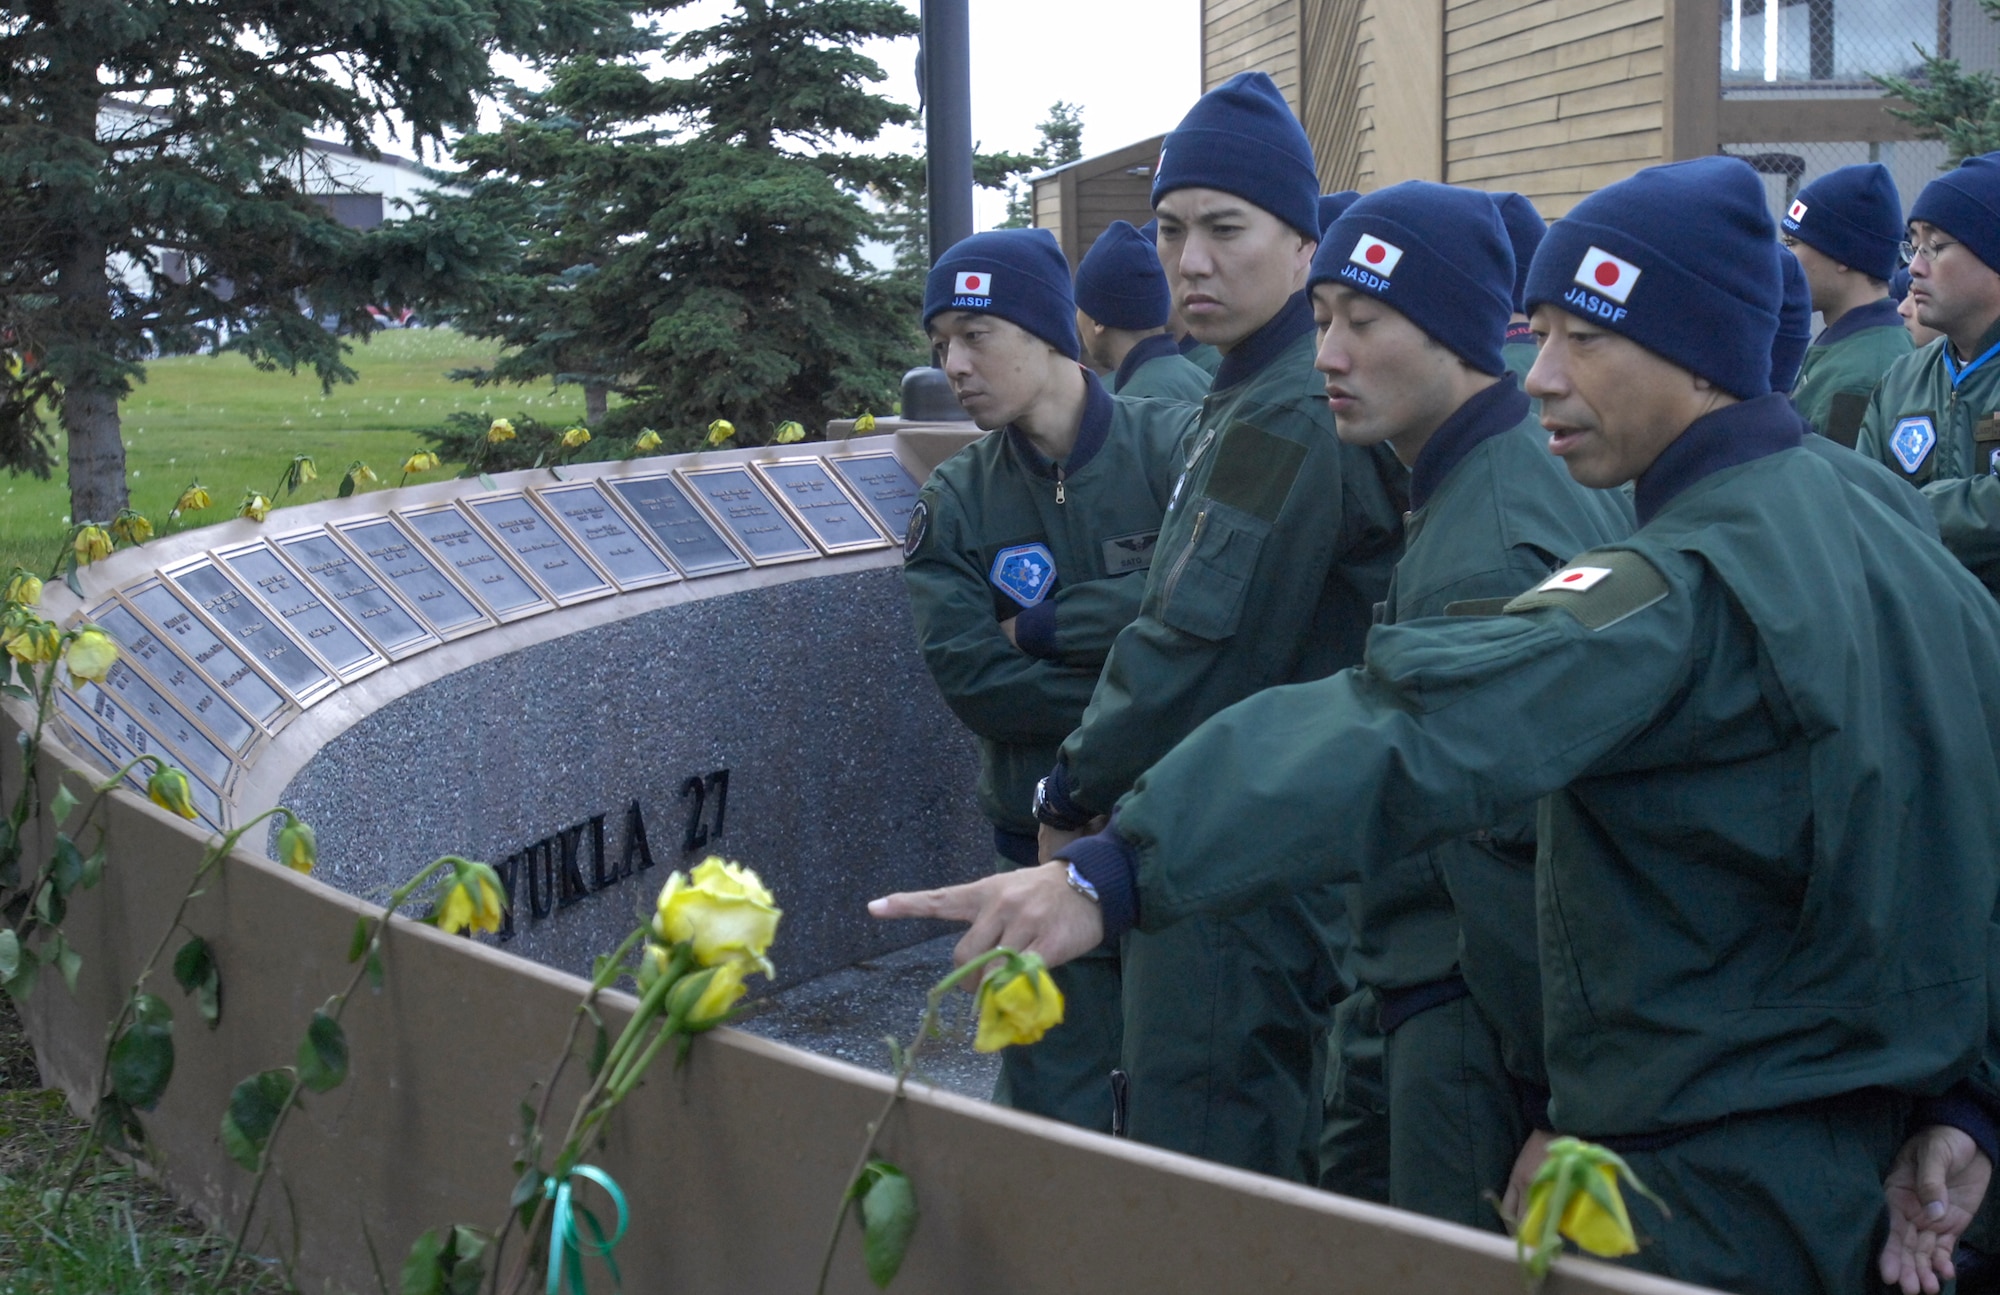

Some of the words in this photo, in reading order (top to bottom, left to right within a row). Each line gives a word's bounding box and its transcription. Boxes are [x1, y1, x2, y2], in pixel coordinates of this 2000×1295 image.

[1340, 264, 1391, 292] JASDF
[951, 296, 992, 308] JASDF
[1564, 287, 1628, 323] JASDF
[1120, 556, 1142, 567] SATO
[682, 768, 730, 855] 27
